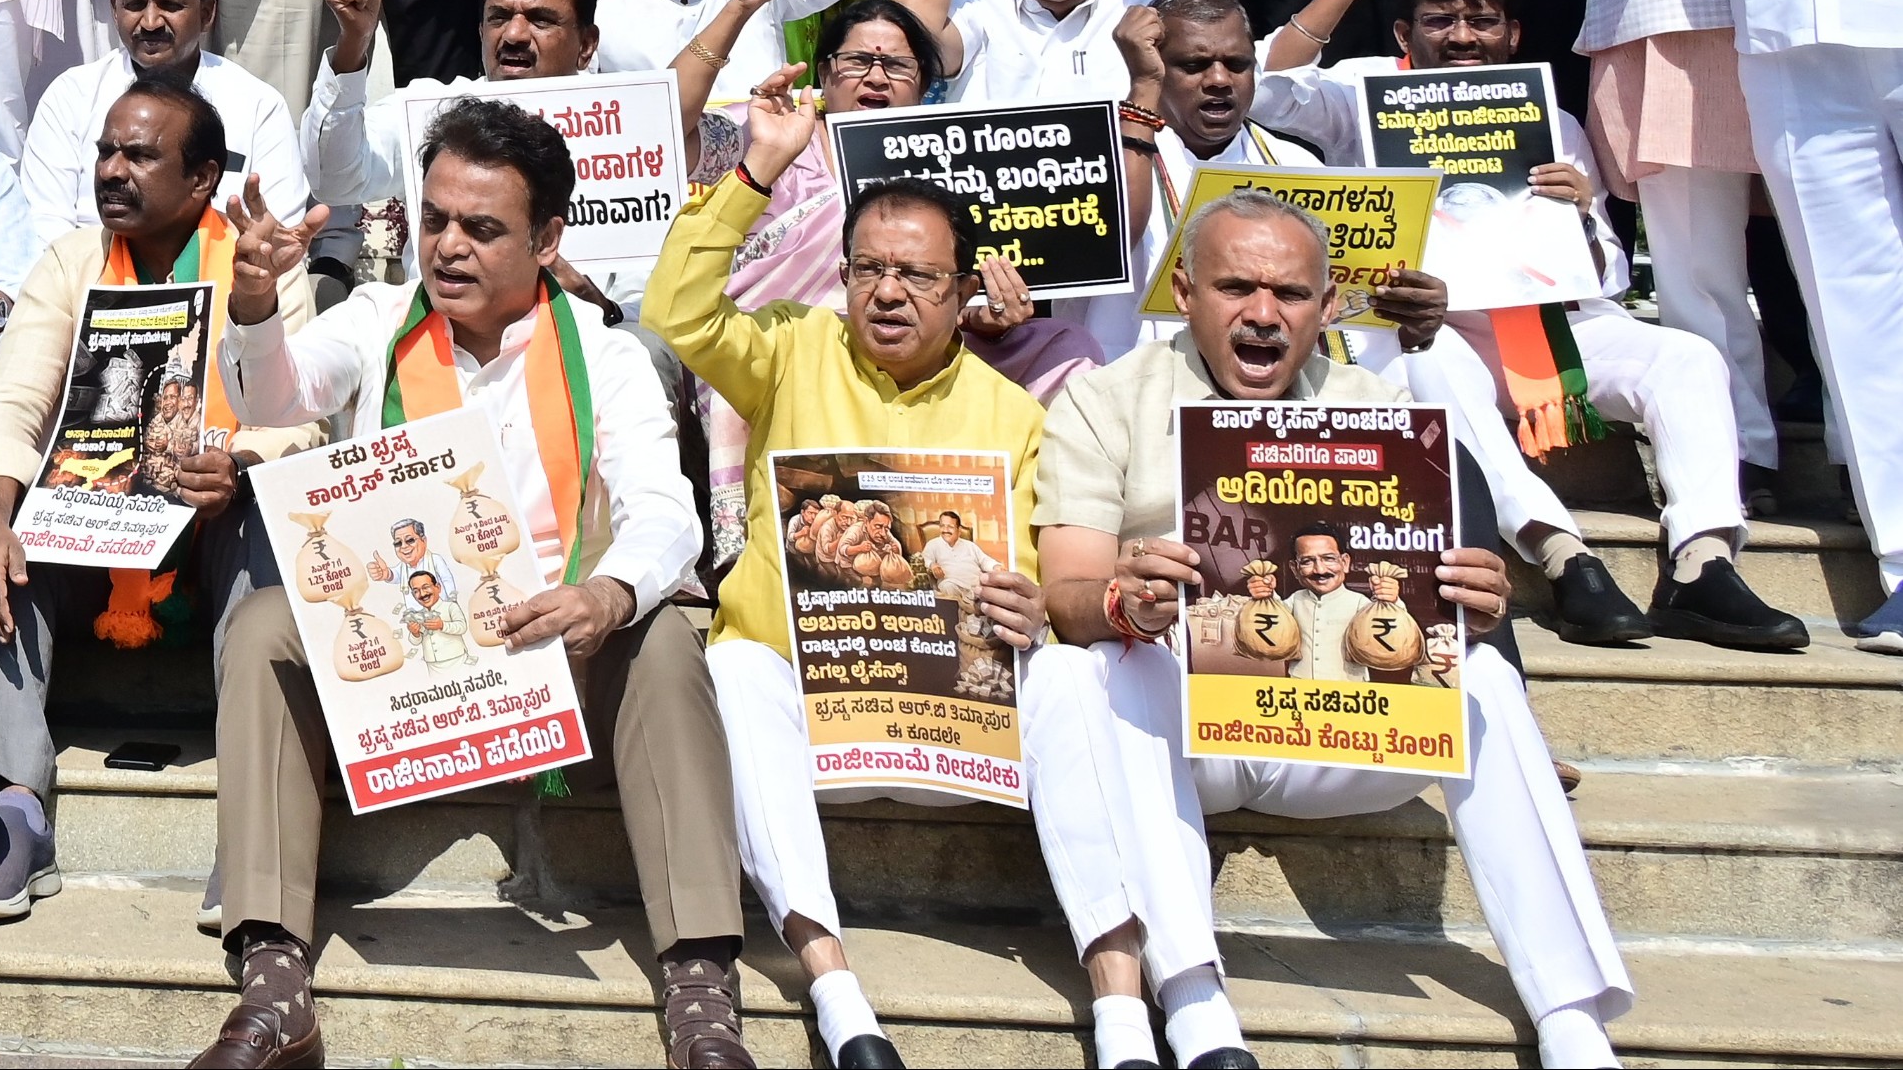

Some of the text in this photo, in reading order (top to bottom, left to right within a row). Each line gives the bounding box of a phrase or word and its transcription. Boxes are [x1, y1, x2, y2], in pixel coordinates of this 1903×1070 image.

[1452, 81, 1528, 102] ಹೋರಾಟ
[1452, 101, 1541, 126] ರಾಜೀನಾಮೆ
[973, 123, 1071, 153] ಗೂಂಡಾ
[997, 155, 1108, 193] ಬಂಧಿಸದ
[988, 194, 1108, 237] ಸರ್ಕಾರಕ್ಕೆ
[1212, 407, 1262, 429] ಬಾರ್
[328, 445, 367, 470] ಕಡು
[1334, 447, 1378, 466] ಪಾಲು
[306, 448, 456, 507] ಕಾಂಗ್ರೆಸ್ ಸರ್ಕಾರ
[1216, 469, 1334, 506] ಆಡಿಯೋ
[1183, 510, 1269, 553] BAR
[1349, 522, 1445, 552] ಬಹಿರಂಗ
[798, 610, 877, 633] ಅಬಕಾರಿ
[870, 638, 907, 653] ಲಂಚ
[851, 697, 894, 713] ಸಚಿವ
[1304, 688, 1389, 717] ಸಚಿವರೇ
[392, 715, 430, 740] ಸಚಿವ
[907, 724, 961, 745] ಕೂಡಲೇ
[1197, 719, 1454, 764] ರಾಜೀನಾಮೆ ಕೊಟ್ಟು ತೊಲಗಿ
[365, 719, 566, 794] ರಾಜೀನಾಮೆ ಪಡೆಯಿರಿ
[816, 748, 1020, 790] ರಾಜೀನಾಮೆ ನೀಡಬೇಕು
